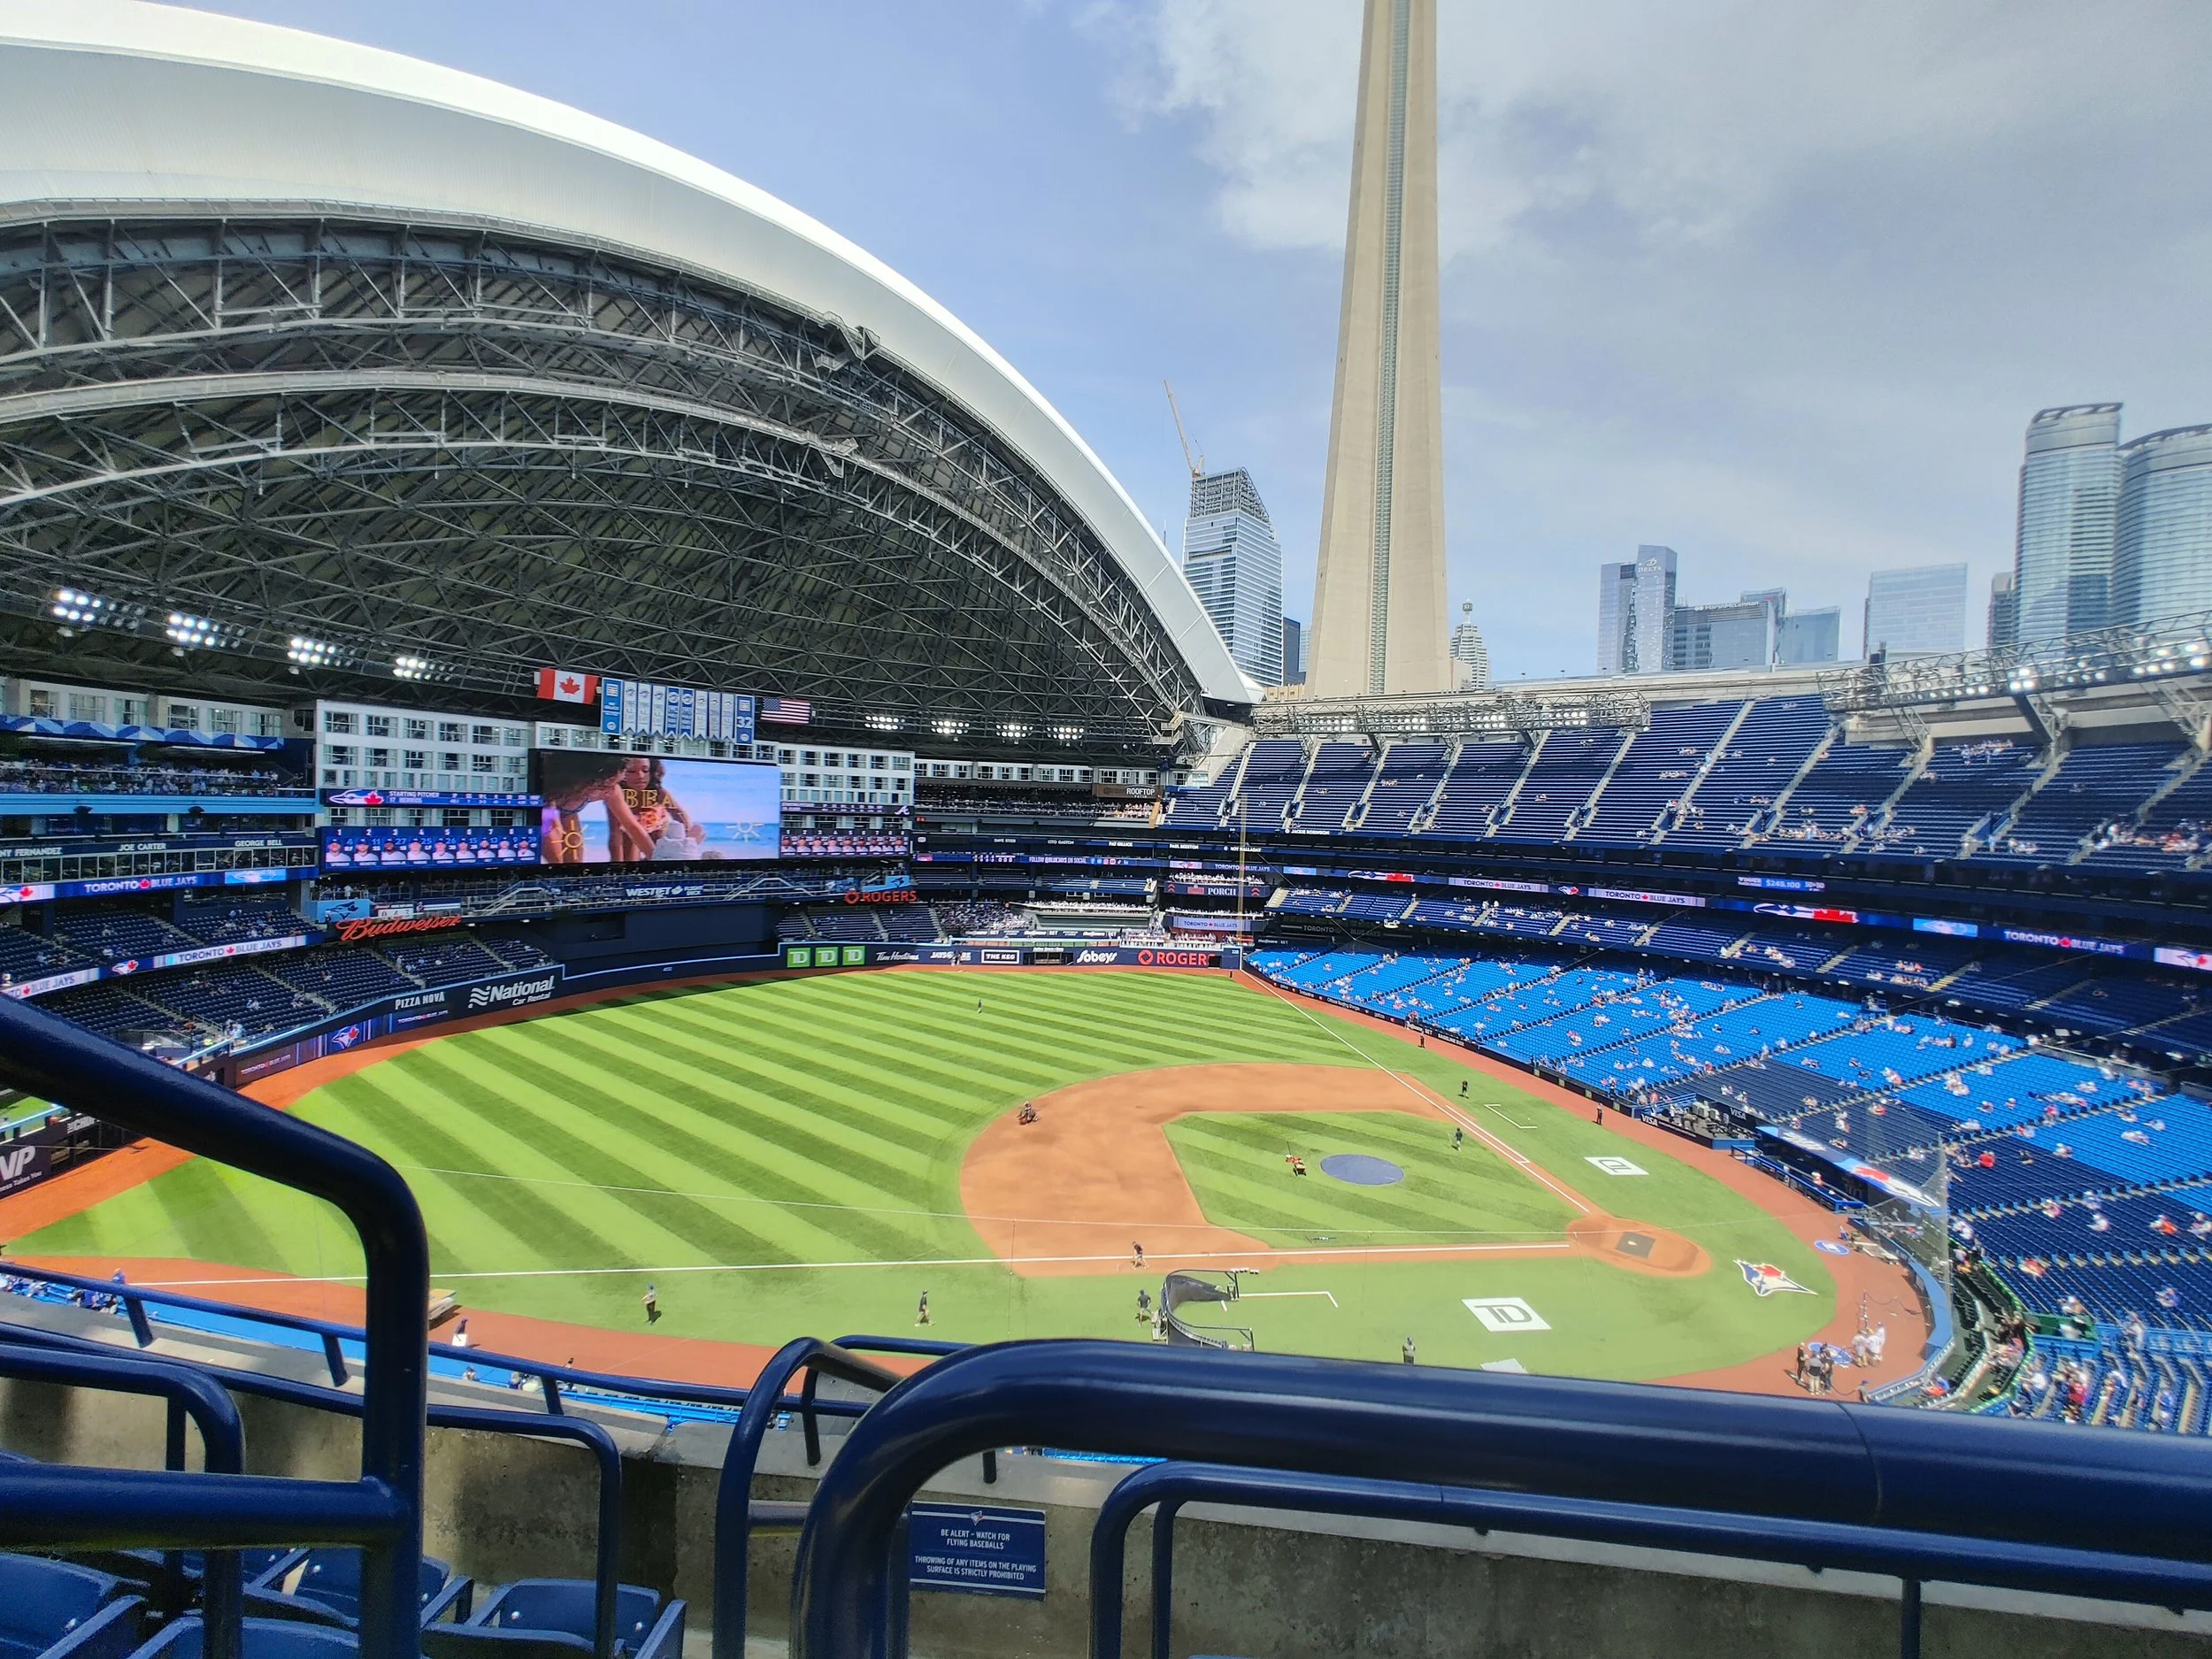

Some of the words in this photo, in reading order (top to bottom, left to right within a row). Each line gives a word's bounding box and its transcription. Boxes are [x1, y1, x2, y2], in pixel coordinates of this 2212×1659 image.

[736, 716, 752, 729] 32
[14, 848, 63, 856] FERNANDEZ
[137, 842, 166, 851] CARTER
[84, 880, 140, 893] TORONTO
[150, 878, 173, 888] BLUE
[175, 876, 197, 886] JAYS
[1463, 879, 1494, 888] TORONTO
[862, 890, 918, 902] ROGERS
[1208, 887, 1237, 895] PORCH
[1605, 890, 1640, 899] TORONTO
[335, 914, 462, 941] Budweiser
[2003, 931, 2060, 946] TORONTO
[2070, 939, 2097, 950] BLUE
[2097, 943, 2124, 954] JAYS
[179, 948, 225, 963] TORONTO
[235, 943, 258, 954] BLUE
[260, 940, 282, 950] JAYS
[789, 951, 808, 964] TD
[818, 950, 835, 963] TD
[844, 949, 862, 961] TD
[876, 952, 890, 961] Tim
[890, 951, 920, 961] Hortons
[1076, 949, 1118, 964] Sobeys
[52, 975, 75, 987] JAYS
[488, 975, 555, 1002] National
[395, 996, 421, 1010] PIZZA
[422, 991, 446, 1005] NOVA
[512, 997, 526, 1007] Car
[527, 991, 551, 1003] Rental
[1640, 1113, 1658, 1126] VISA
[1730, 1108, 1747, 1120] VISA
[1597, 1159, 1632, 1173] TD
[1474, 1304, 1532, 1324] TD
[950, 1529, 970, 1538] ALERT
[998, 1532, 1010, 1541] FOR
[947, 1538, 968, 1547] FLYING
[970, 1540, 1003, 1550] BASEBALLS
[915, 1555, 946, 1565] THROWING
[947, 1557, 955, 1566] OF
[956, 1558, 968, 1567] ANY
[970, 1559, 987, 1568] ITEMS
[988, 1561, 998, 1570] ON
[1010, 1563, 1037, 1573] PLAYING
[927, 1564, 953, 1575] SURFACE
[961, 1568, 987, 1578] STRICTLY
[989, 1570, 1025, 1580] PROHIBITED
